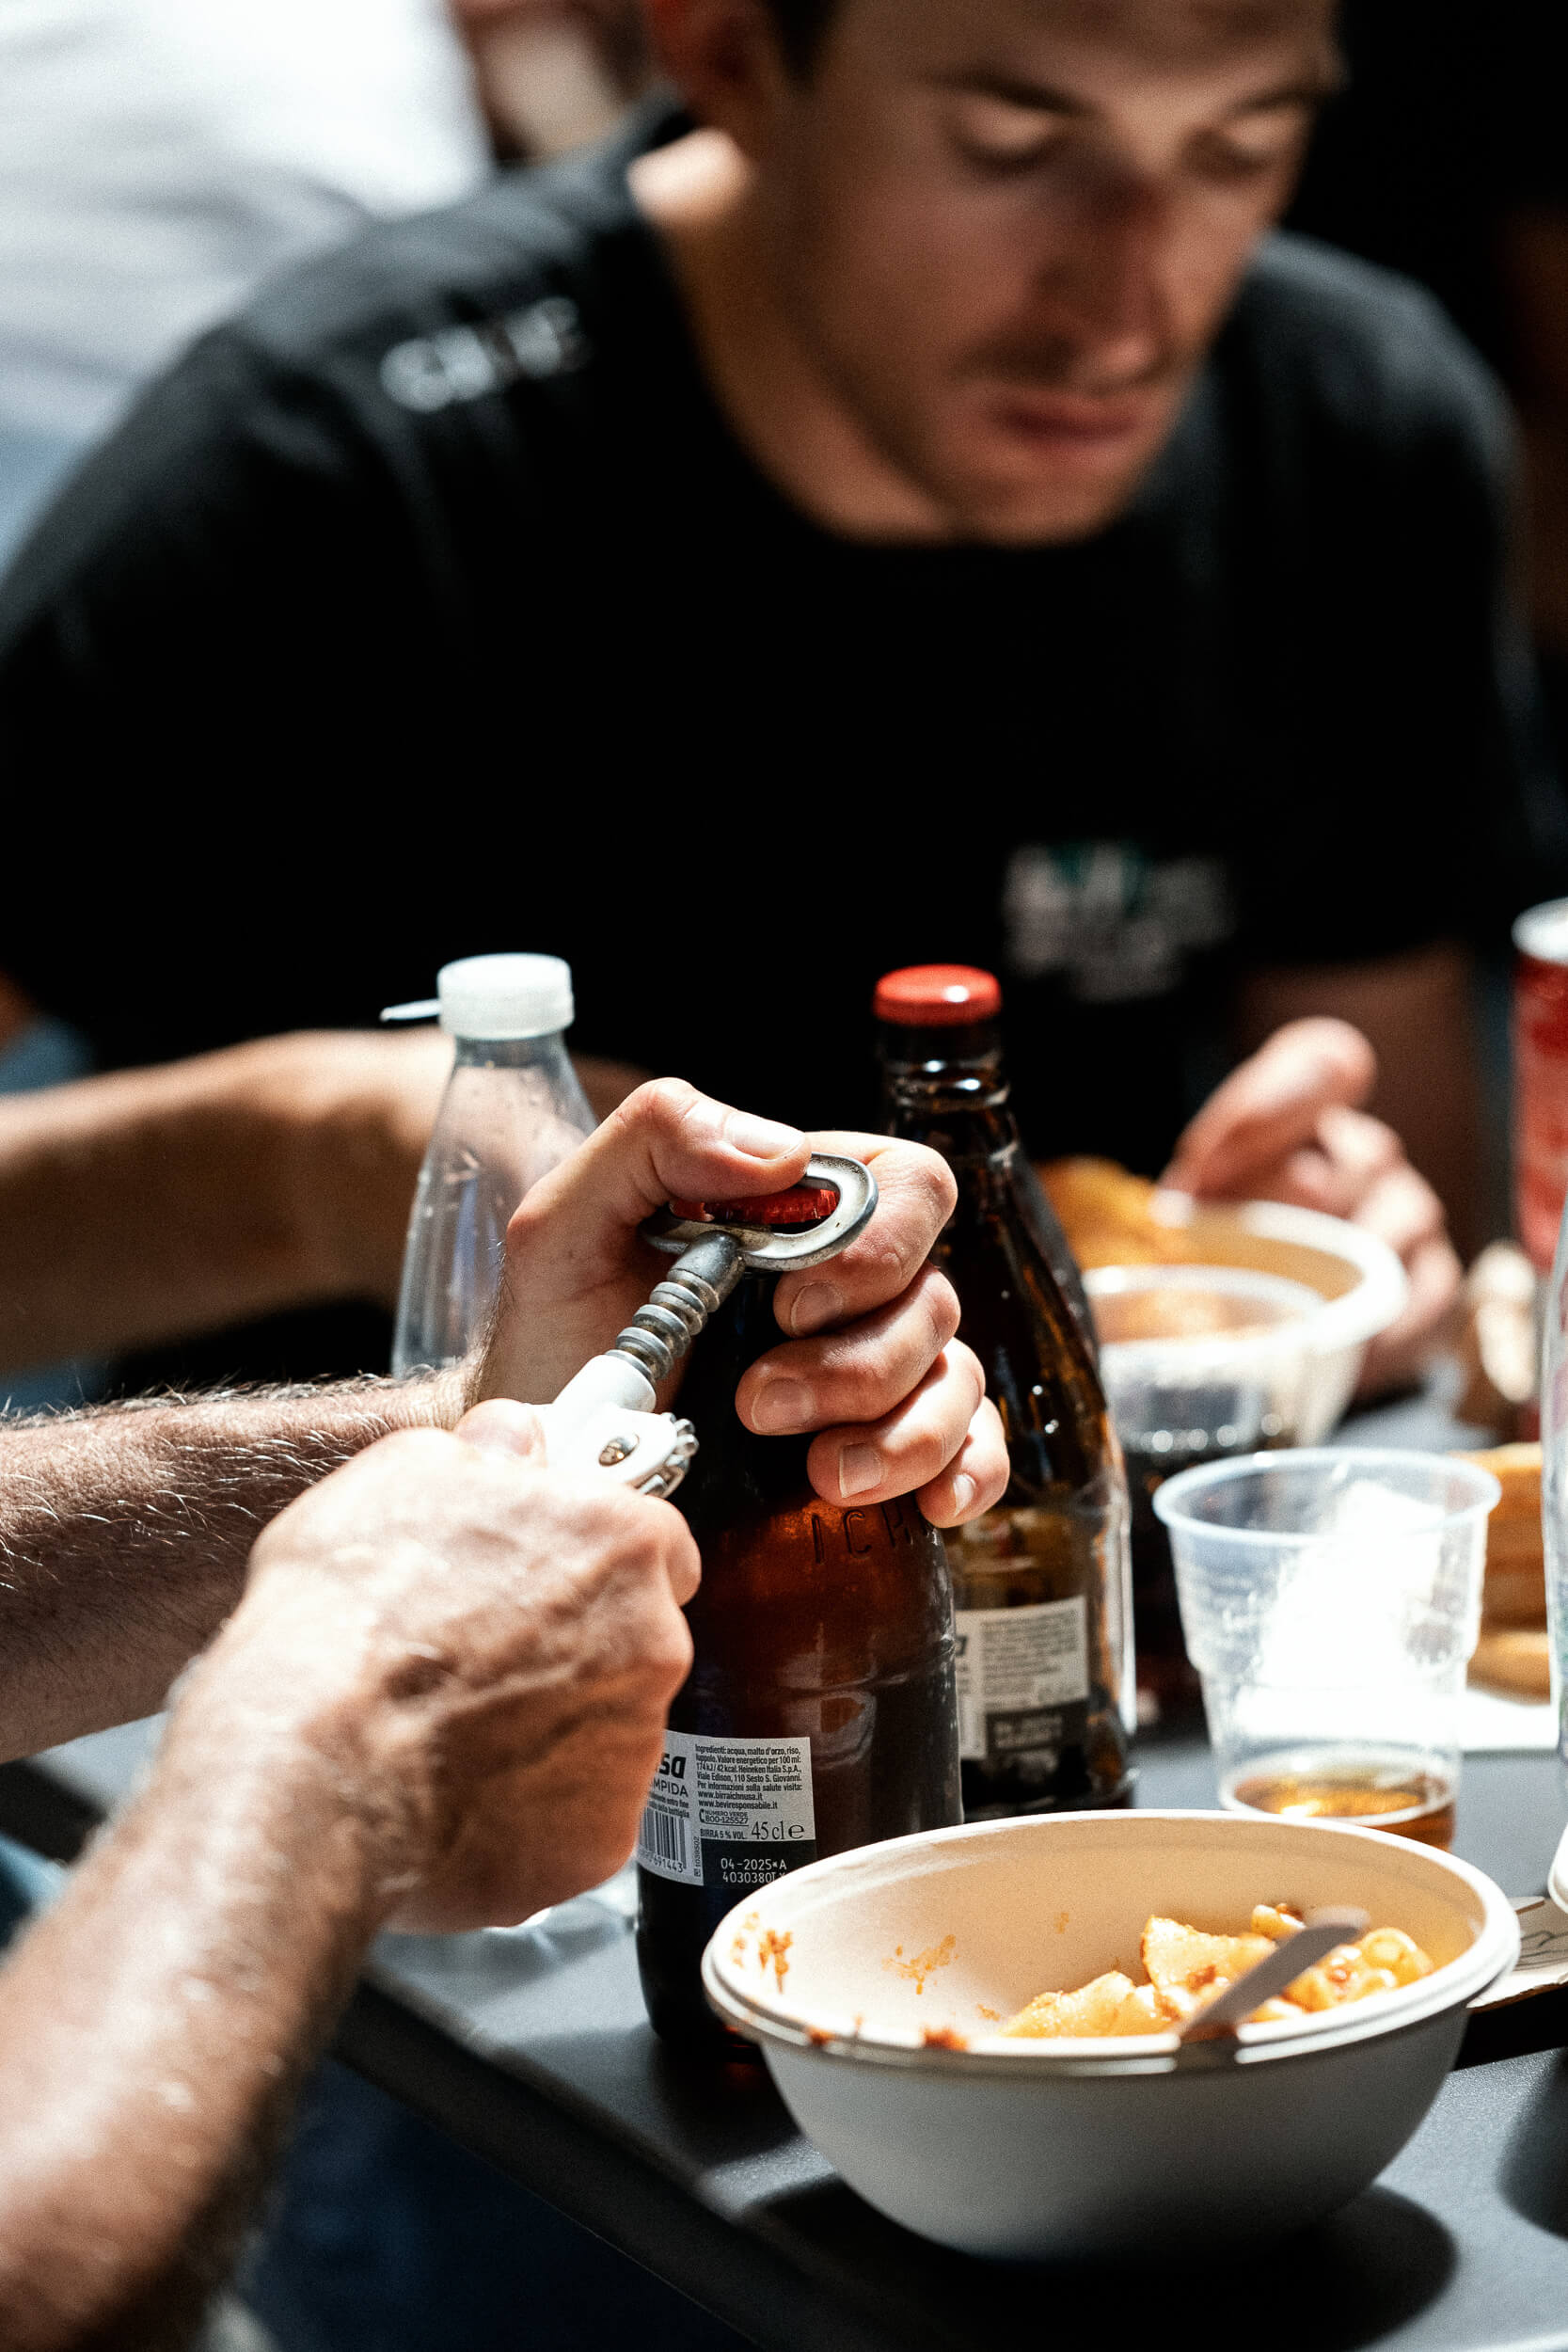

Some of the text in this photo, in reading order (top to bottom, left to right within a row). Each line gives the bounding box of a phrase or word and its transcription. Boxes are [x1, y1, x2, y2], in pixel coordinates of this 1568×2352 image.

[695, 1743, 726, 1755] Ingredienti:
[727, 1747, 747, 1756] acqua,
[786, 1746, 800, 1755] riso,
[736, 1756, 768, 1766] energetico
[738, 1765, 766, 1773] Heineken
[697, 1772, 710, 1780] Viale
[712, 1772, 733, 1782] Edison,
[772, 1774, 802, 1783] Giovanni.
[697, 1780, 706, 1788] Per
[708, 1782, 744, 1791] informazioni
[746, 1783, 761, 1791] sulla
[698, 1790, 763, 1801] www.birraichnusa.it
[698, 1800, 778, 1811] www.beviresponsabile.it
[700, 1828, 720, 1838] BIRRA
[752, 1821, 769, 1840] 45
[772, 1820, 784, 1839] cl
